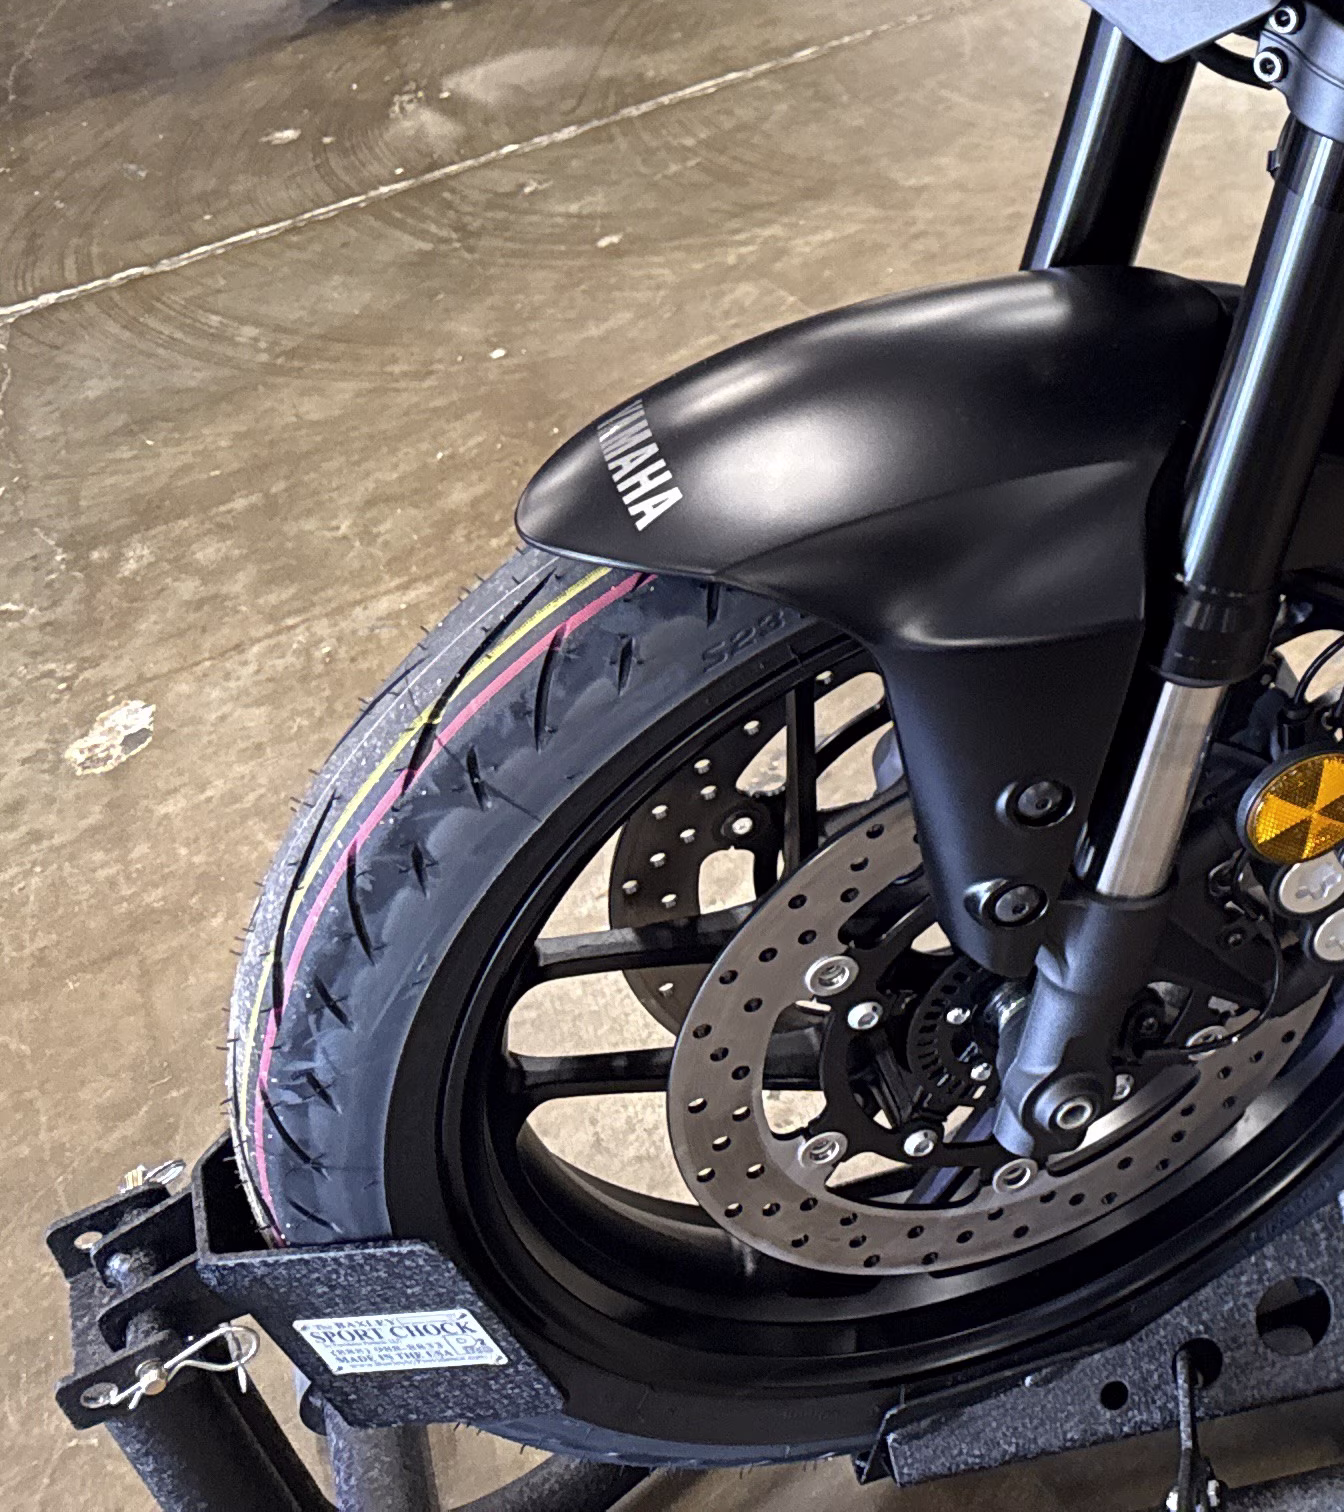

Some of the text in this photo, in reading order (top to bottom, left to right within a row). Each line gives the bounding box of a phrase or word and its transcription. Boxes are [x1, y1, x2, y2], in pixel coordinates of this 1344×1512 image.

[597, 397, 684, 532] YAMAHA
[309, 1327, 385, 1344] SPORT
[389, 1321, 477, 1339] CHOCK
